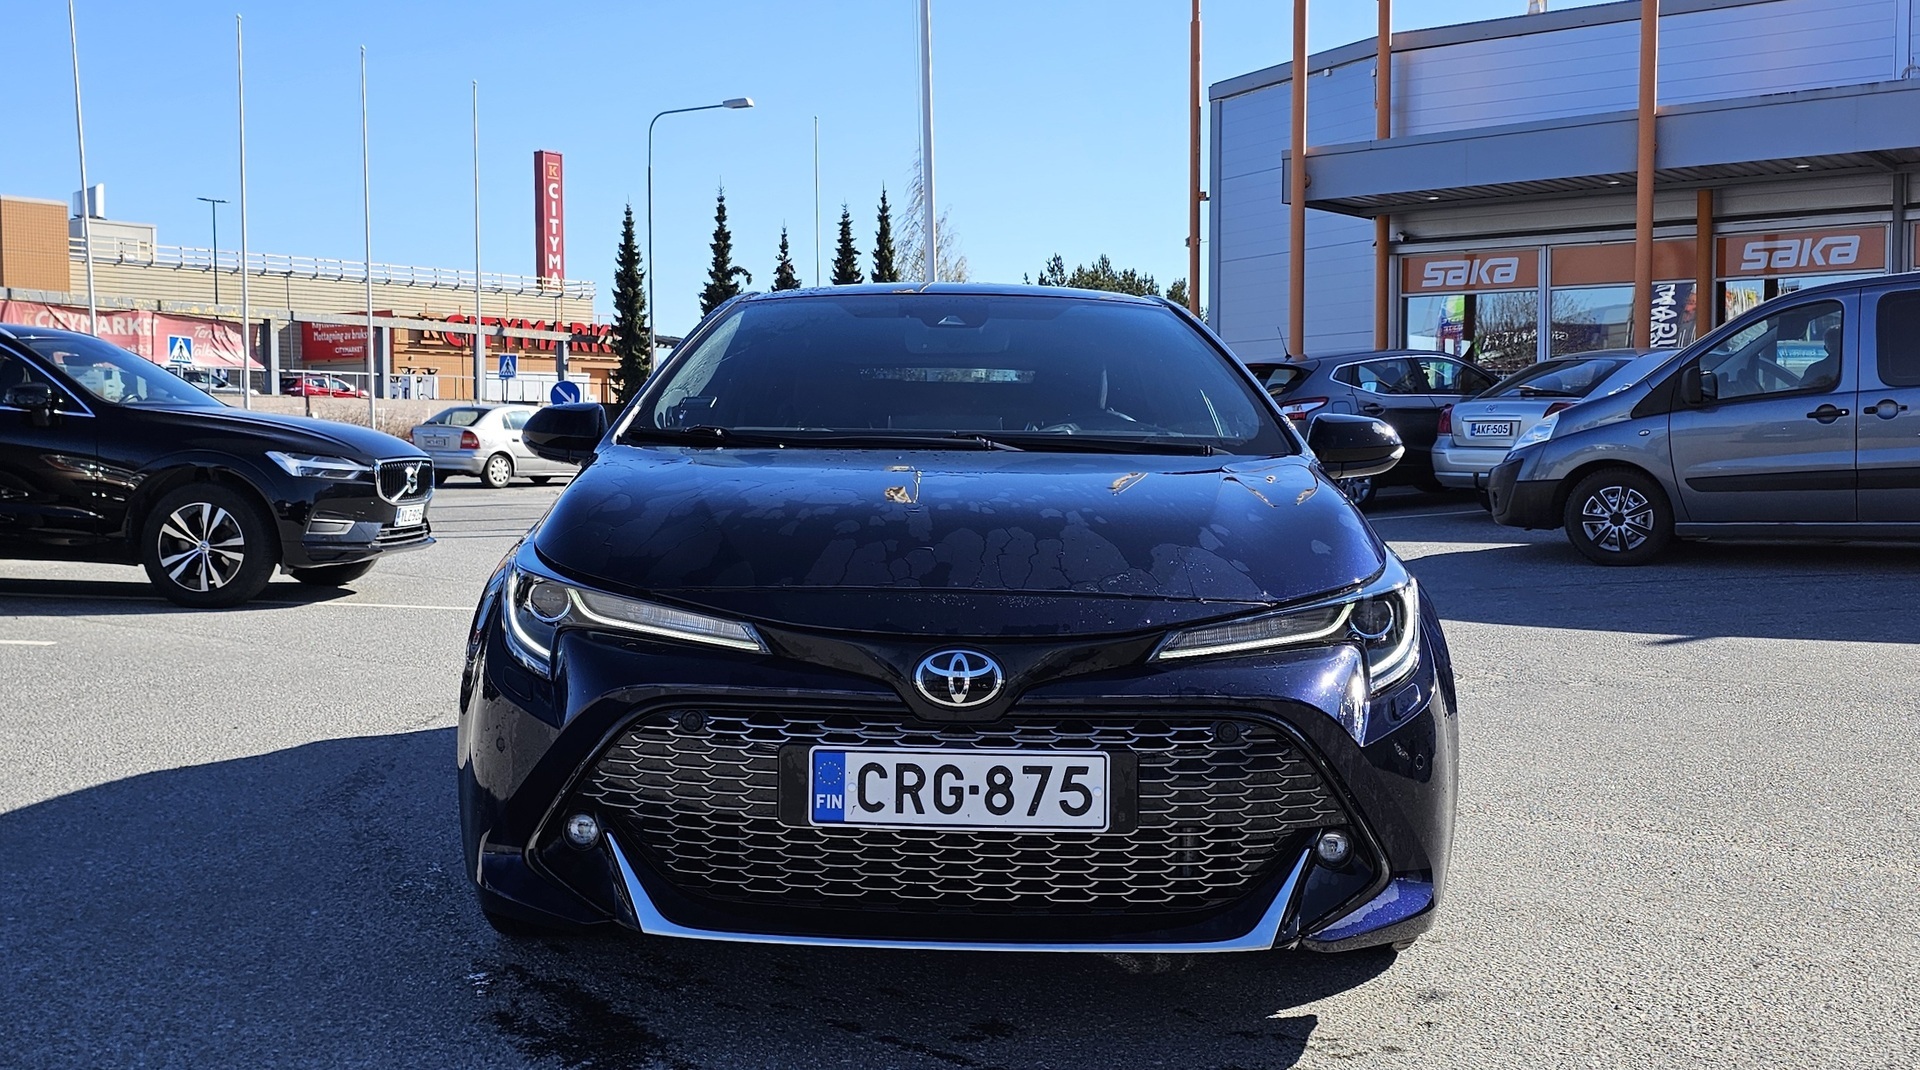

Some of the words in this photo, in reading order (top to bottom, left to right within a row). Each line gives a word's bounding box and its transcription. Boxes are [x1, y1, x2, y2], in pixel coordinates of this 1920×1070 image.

[445, 314, 613, 353] CITYMARK
[1475, 424, 1508, 434] AKF-505
[816, 794, 842, 809] FIN
[857, 762, 1092, 816] CRG-875
